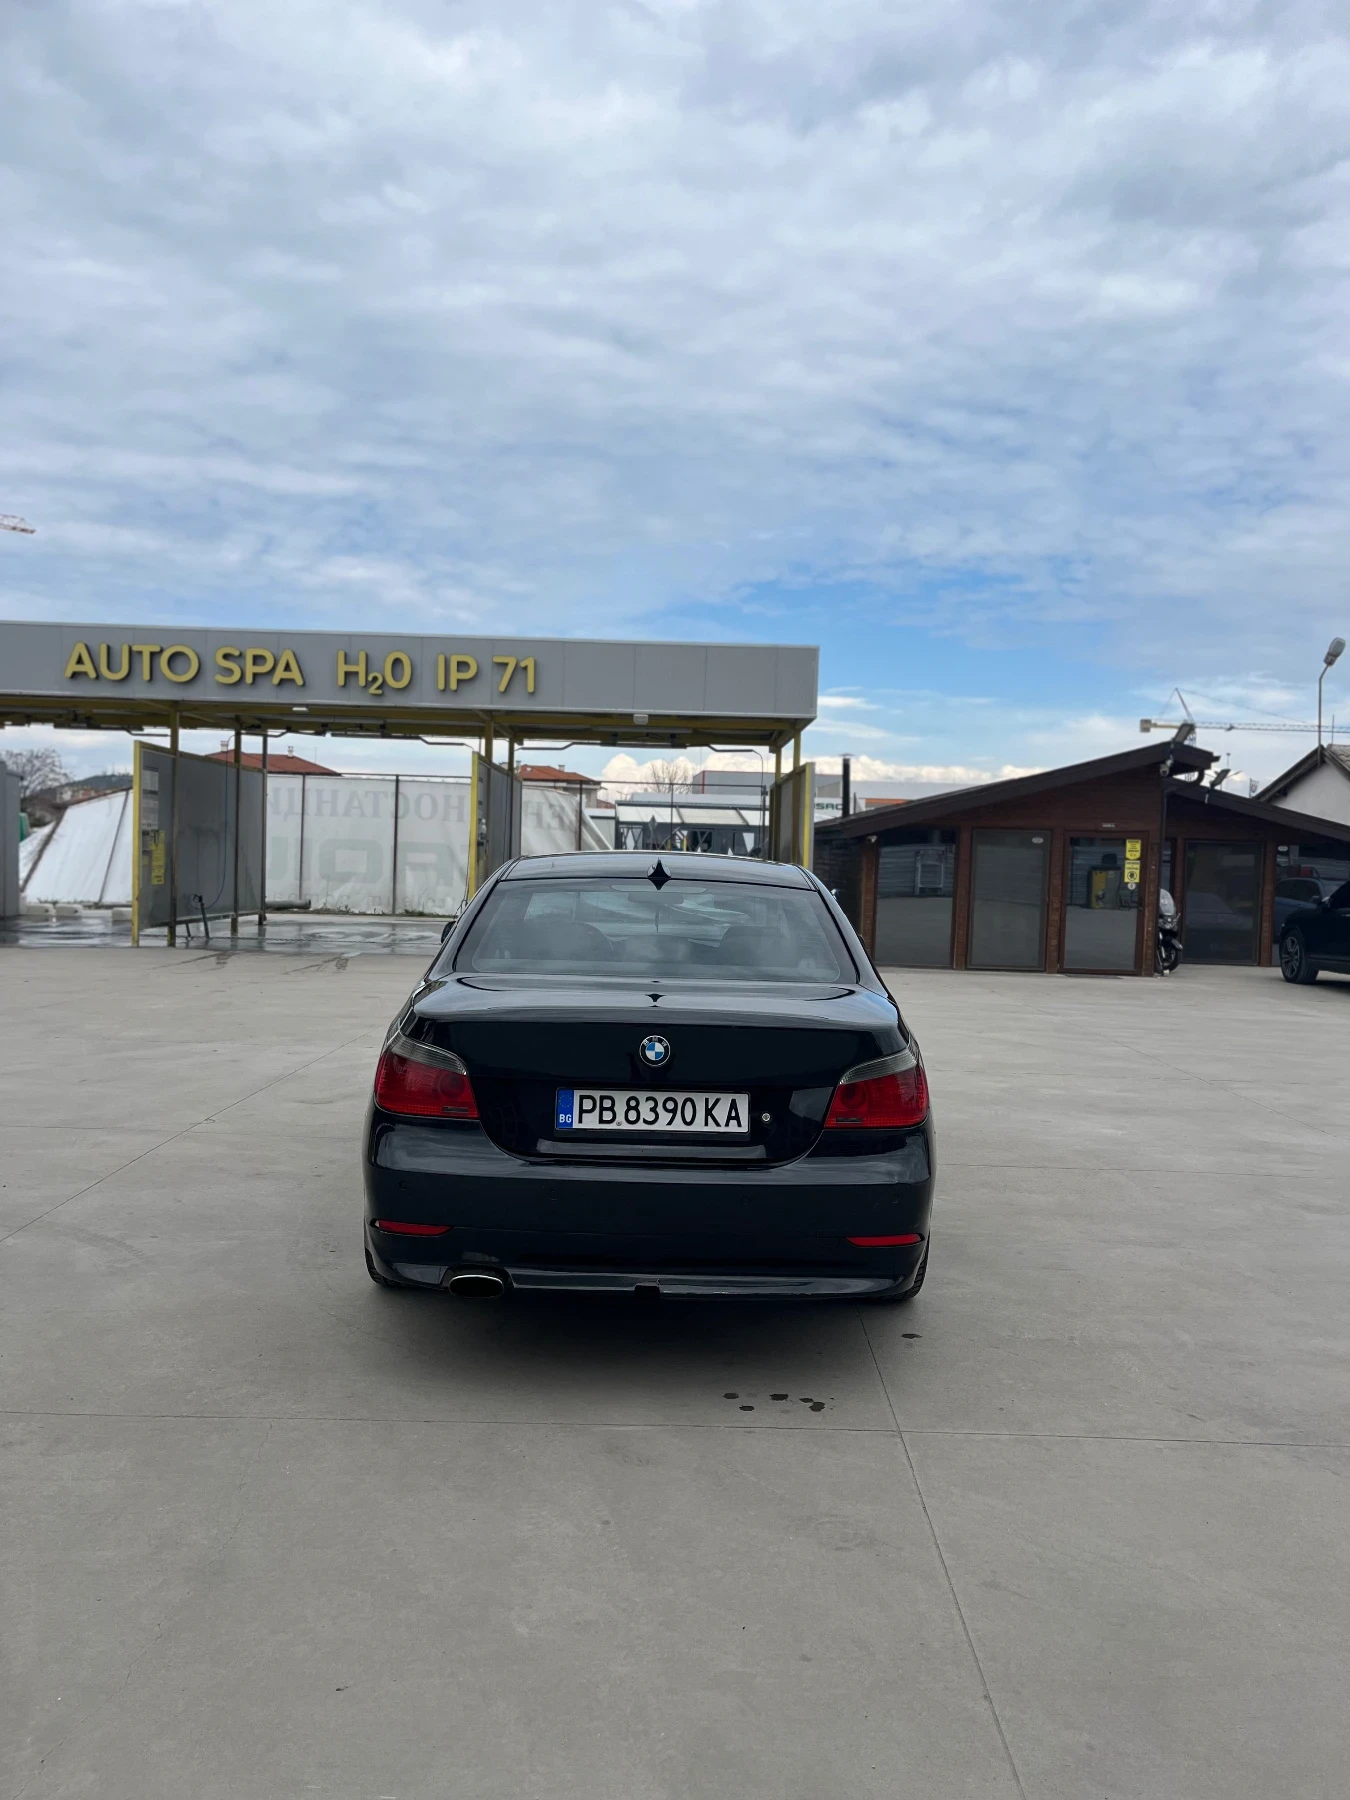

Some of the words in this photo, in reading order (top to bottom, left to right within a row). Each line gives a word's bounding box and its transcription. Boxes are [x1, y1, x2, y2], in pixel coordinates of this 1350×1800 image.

[64, 641, 200, 684] AUTO
[214, 646, 305, 687] SPA
[437, 653, 478, 692] IP
[492, 656, 536, 694] 71
[559, 1113, 572, 1124] BG
